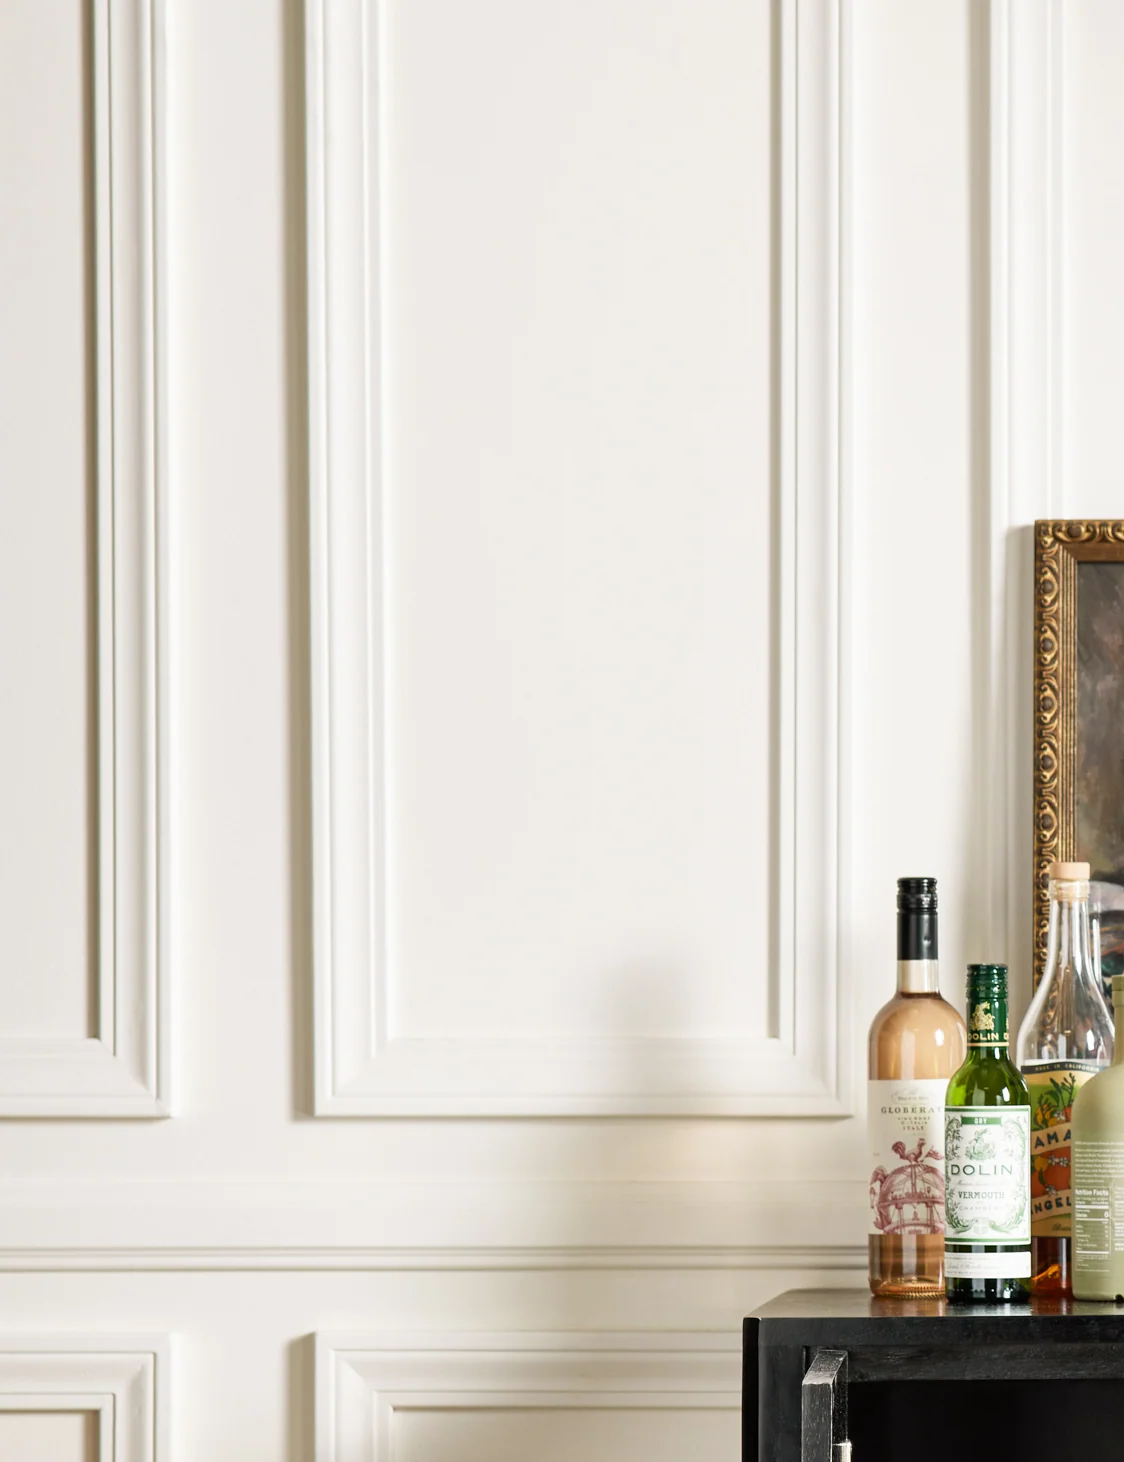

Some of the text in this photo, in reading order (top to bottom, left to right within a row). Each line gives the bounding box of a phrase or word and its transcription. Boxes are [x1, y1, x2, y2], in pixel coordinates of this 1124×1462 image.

[967, 1032, 1000, 1041] DOLIN
[951, 1164, 1012, 1176] DOLIN
[957, 1191, 1005, 1199] VERMOUTH
[1031, 1196, 1071, 1215] NGEL
